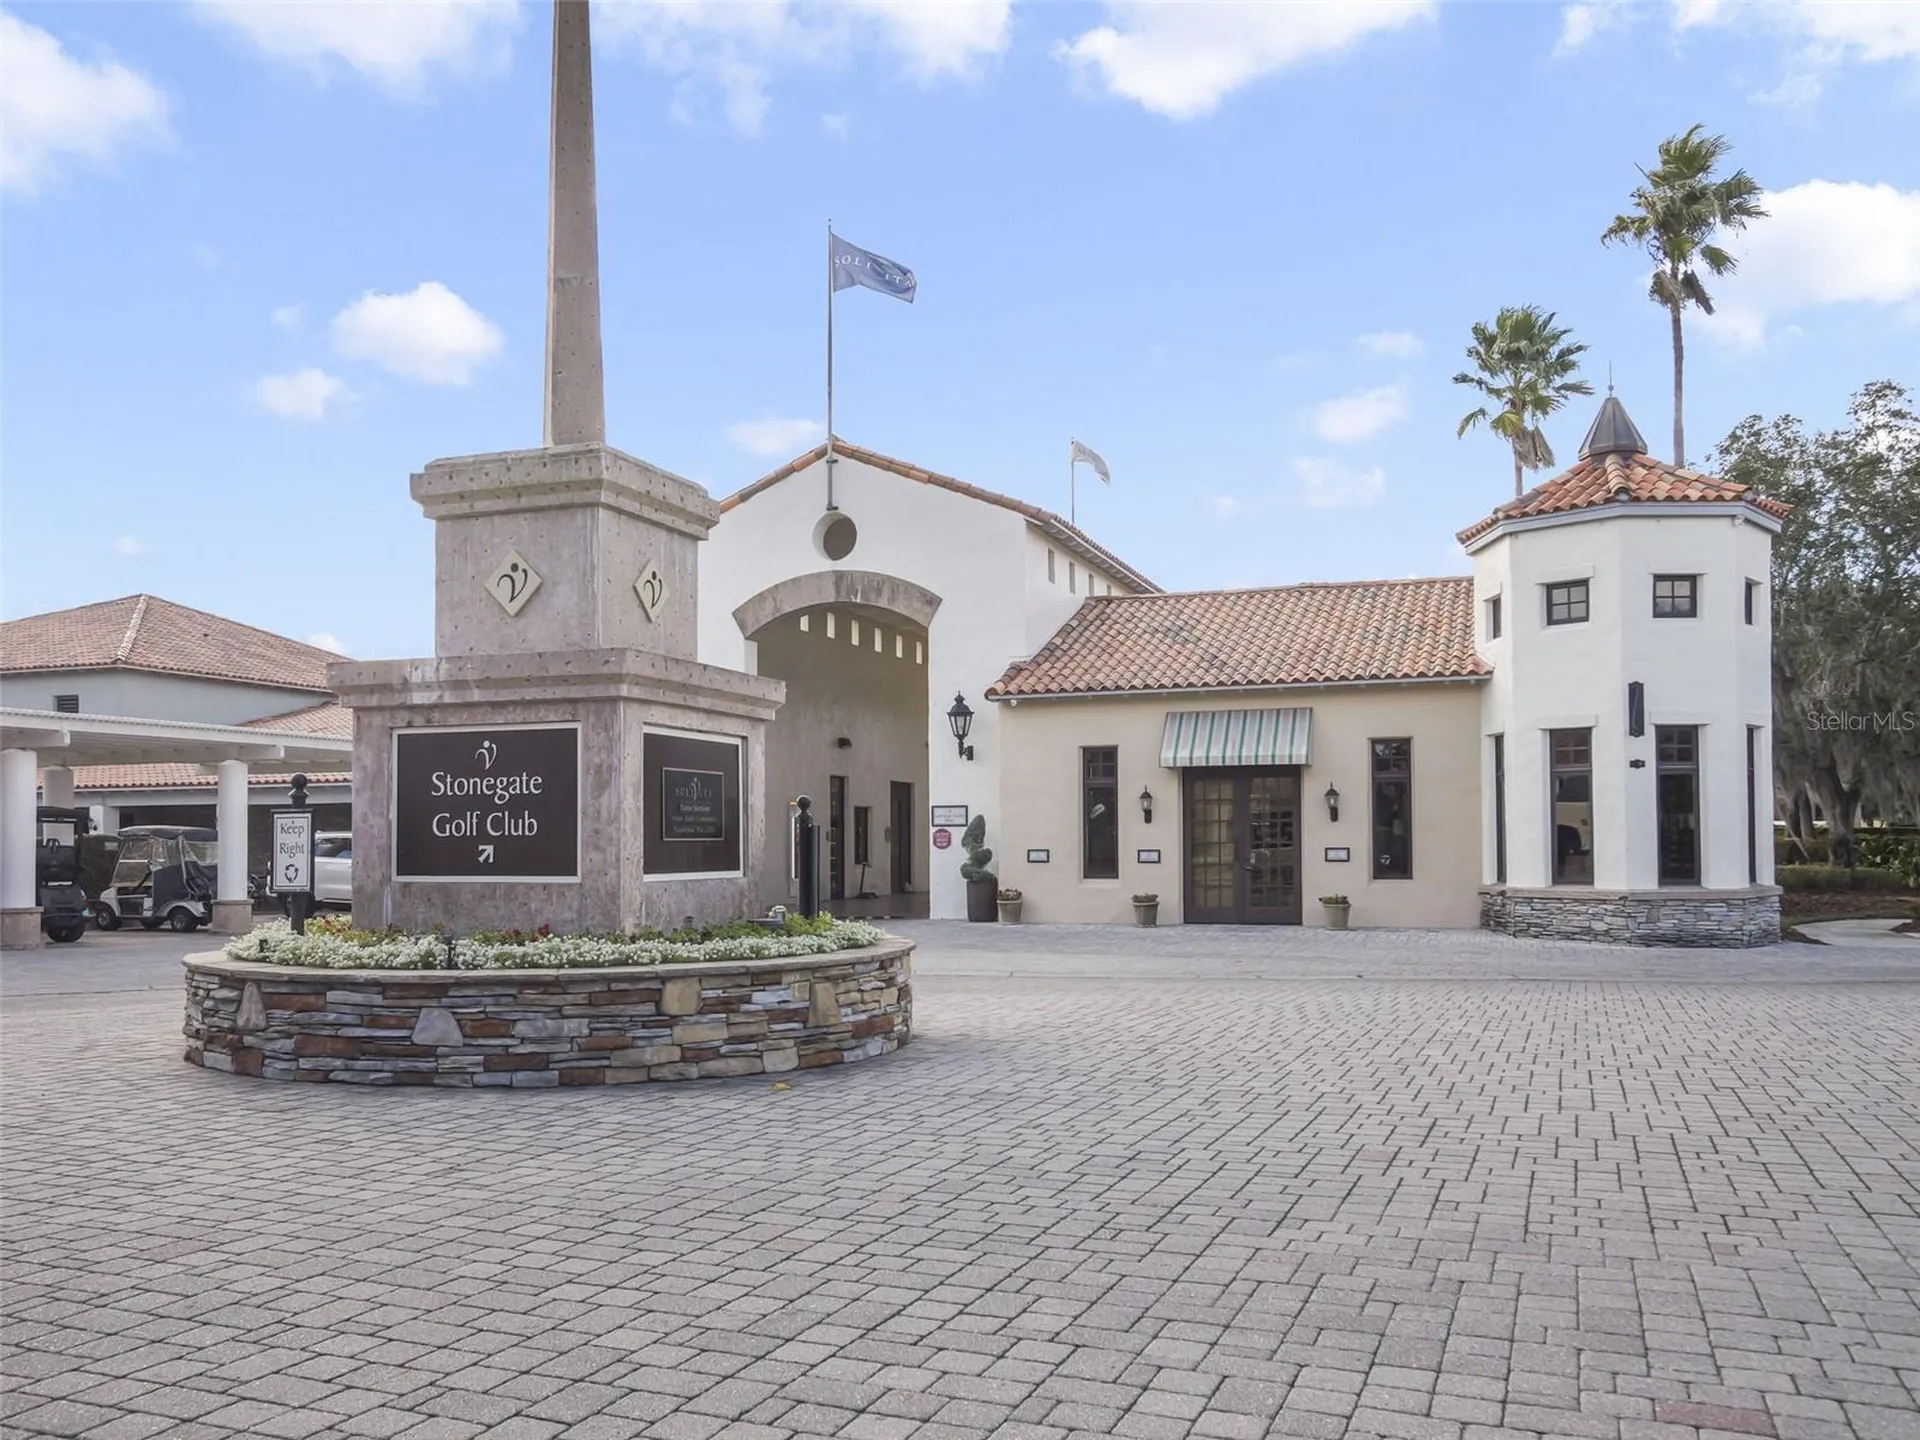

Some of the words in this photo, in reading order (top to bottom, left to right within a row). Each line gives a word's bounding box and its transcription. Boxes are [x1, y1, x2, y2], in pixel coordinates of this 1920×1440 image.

[431, 771, 543, 805] Stonegate
[280, 823, 305, 838] Keep
[432, 811, 481, 837] Golf
[486, 810, 538, 836] Club
[280, 842, 305, 859] Right
